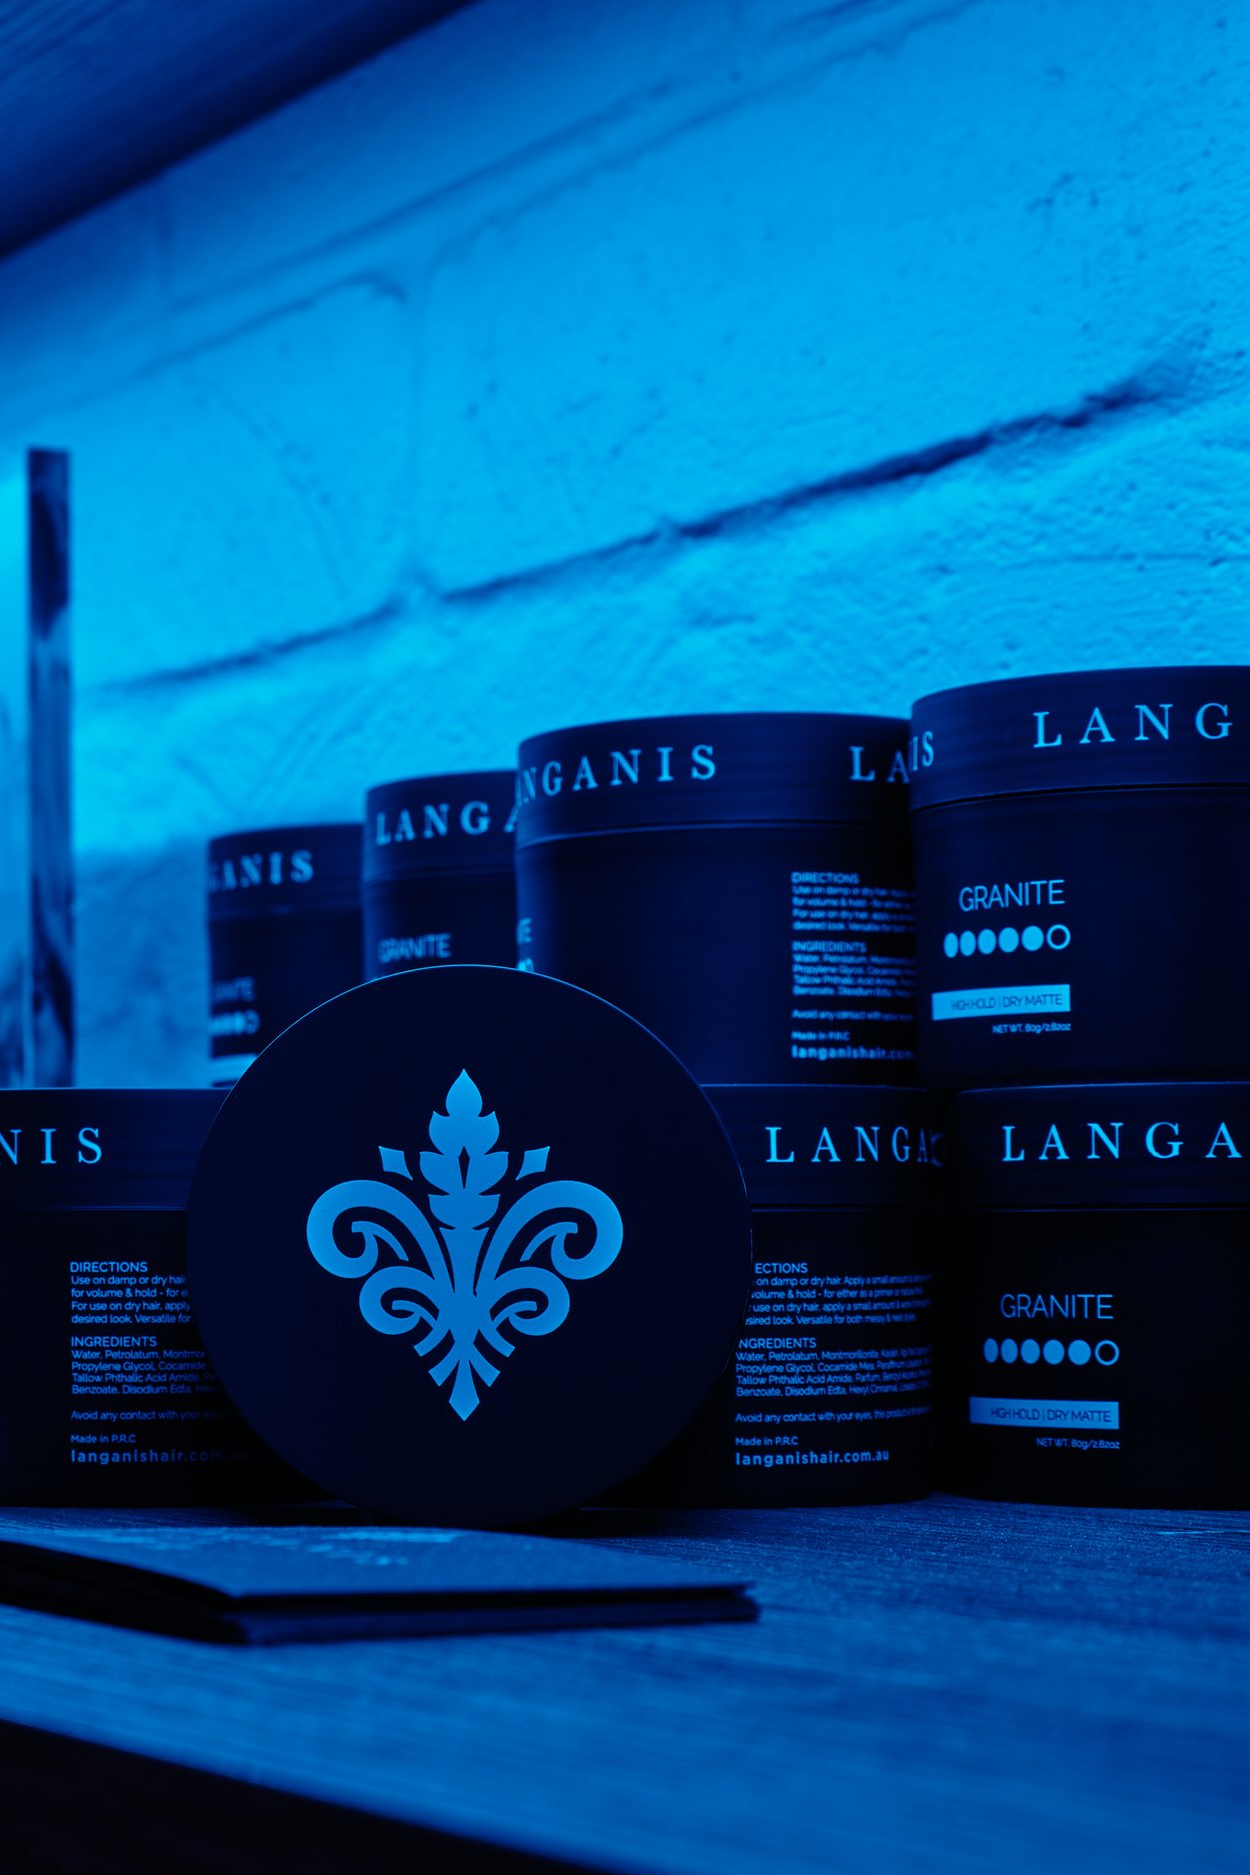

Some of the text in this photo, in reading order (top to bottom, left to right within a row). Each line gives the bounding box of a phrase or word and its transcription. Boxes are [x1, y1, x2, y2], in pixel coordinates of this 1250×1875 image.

[1032, 702, 1234, 748] LANG
[209, 849, 315, 892] ANIS
[791, 872, 861, 884] DIRECTIONS
[958, 879, 1066, 912] GRANITE
[378, 932, 452, 964] GRANITE
[792, 941, 868, 953] INGREDIENTS
[971, 997, 997, 1010] HOLD
[1003, 995, 1025, 1008] DRY
[1025, 993, 1063, 1007] MATTE
[992, 1024, 1008, 1034] NET
[1001, 1121, 1242, 1161] LANGA
[70, 1262, 149, 1273] DIRECTIONS
[71, 1275, 91, 1285] Use
[108, 1275, 137, 1287] damp
[151, 1275, 167, 1287] dry
[756, 1278, 769, 1287] on
[770, 1276, 798, 1288] damp
[800, 1278, 809, 1287] or
[810, 1275, 825, 1288] dry
[844, 1275, 865, 1288] Apply
[71, 1288, 84, 1298] for
[86, 1288, 123, 1298] volume
[125, 1288, 133, 1298] &
[135, 1288, 157, 1298] hold
[166, 1288, 179, 1298] for
[787, 1289, 794, 1299] &
[796, 1289, 816, 1299] hold
[824, 1288, 835, 1298] for
[836, 1288, 858, 1298] either
[71, 1301, 87, 1311] For
[89, 1303, 107, 1311] use
[109, 1303, 122, 1311] on
[124, 1301, 141, 1313] dry
[165, 1301, 190, 1313] apply
[753, 1304, 771, 1313] use
[772, 1304, 785, 1312] on
[786, 1301, 801, 1314] dry
[822, 1301, 845, 1314] apply
[999, 1293, 1114, 1320] GRANITE
[71, 1313, 191, 1324] desired look. Versatile for
[796, 1315, 833, 1326] Versatile
[834, 1315, 845, 1325] for
[71, 1336, 158, 1347] INGREDIENTS
[72, 1361, 121, 1374] Propylene
[736, 1362, 784, 1375] Propylene
[817, 1361, 858, 1373] Cocamide
[72, 1373, 102, 1383] Tallow
[104, 1373, 143, 1383] Phthalic
[145, 1373, 166, 1383] Acid
[737, 1374, 766, 1385] Tallow
[768, 1374, 804, 1385] Phthalic
[806, 1373, 825, 1384] Acid
[122, 1384, 168, 1395] Disodium
[785, 1386, 826, 1397] Disodium
[71, 1410, 98, 1421] Avoid
[100, 1412, 117, 1422] any
[119, 1411, 156, 1421] contact
[158, 1411, 178, 1420] with
[735, 1410, 853, 1424] Avoid any contact with your
[1013, 1408, 1040, 1421] HOLD
[1047, 1409, 1069, 1421] DRY
[1071, 1410, 1111, 1423] MATTE
[70, 1434, 97, 1443] Made
[100, 1434, 109, 1443] in
[735, 1436, 762, 1447] Made
[764, 1436, 773, 1447] in
[1036, 1437, 1053, 1447] NET
[735, 1450, 890, 1468] langanishair.com.au
